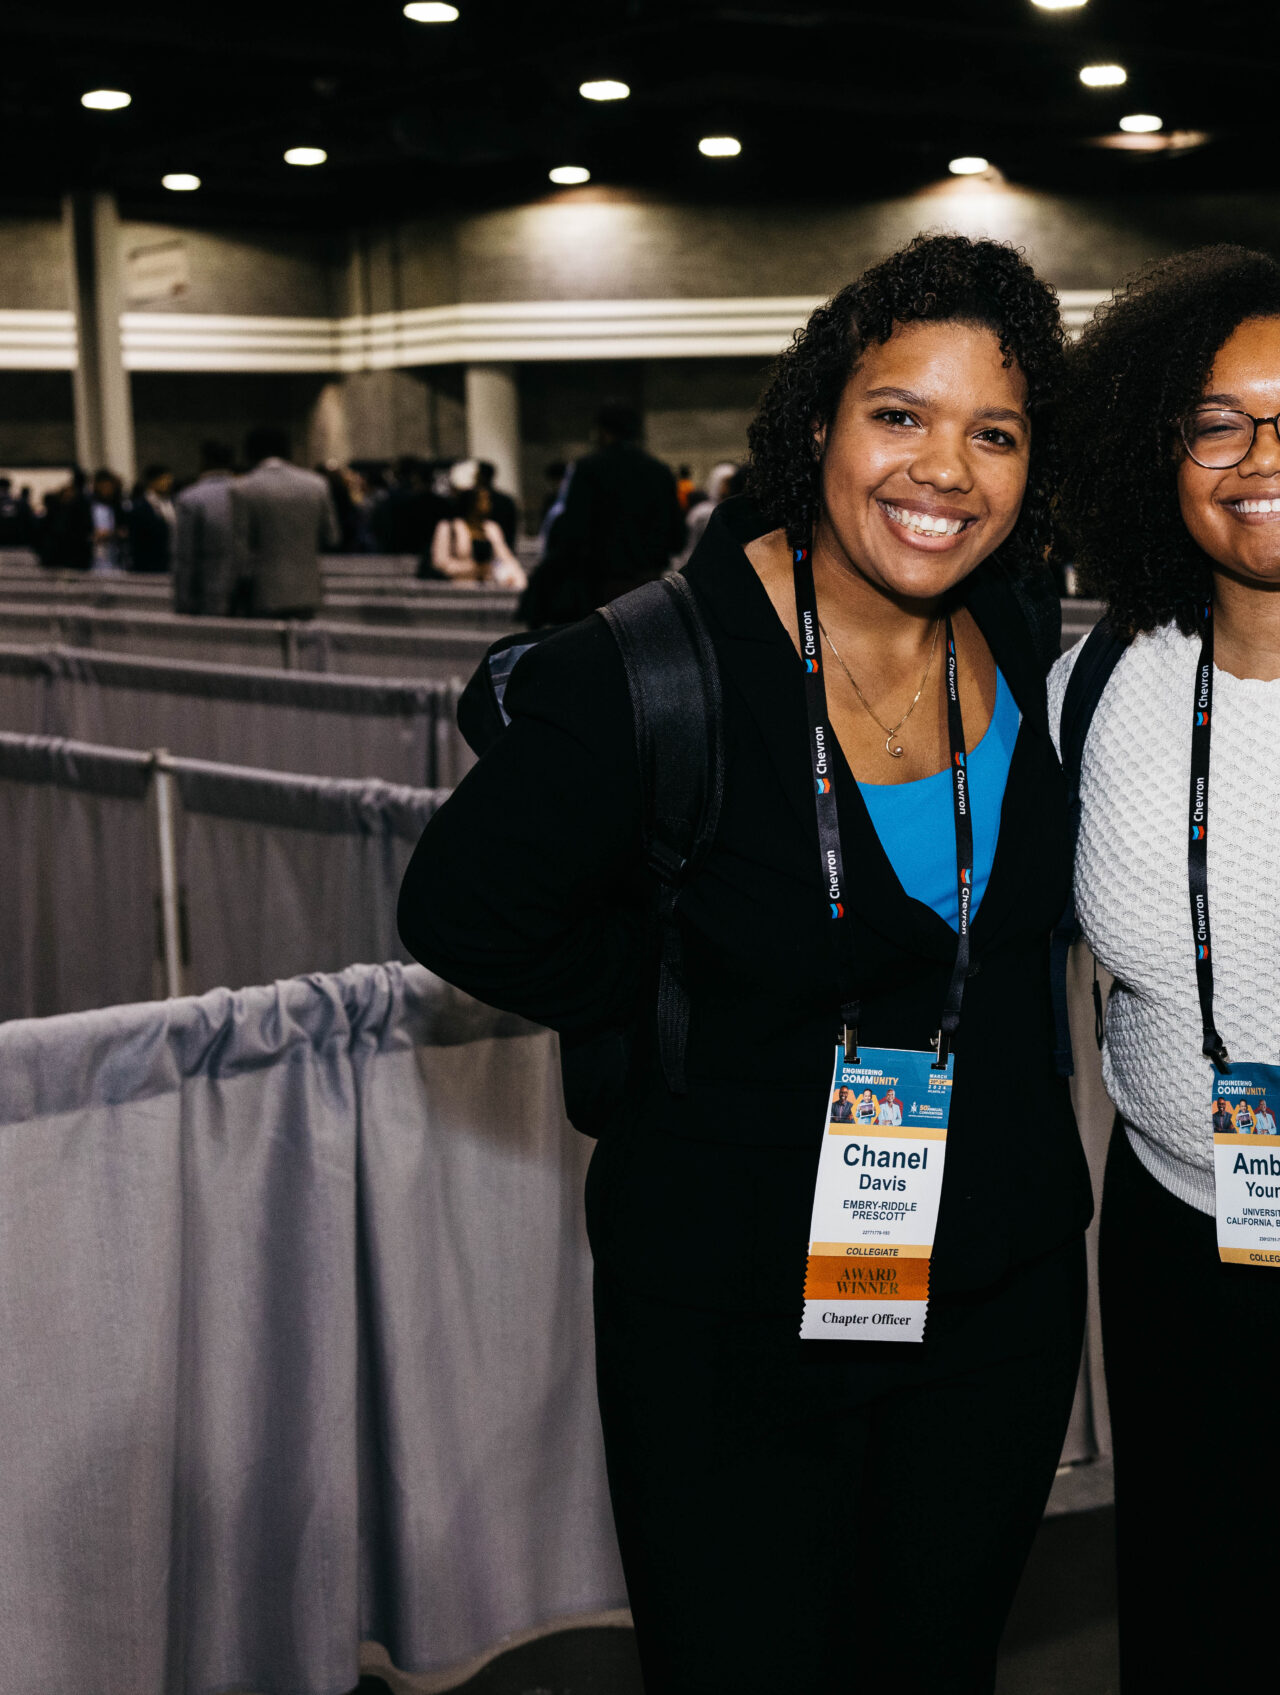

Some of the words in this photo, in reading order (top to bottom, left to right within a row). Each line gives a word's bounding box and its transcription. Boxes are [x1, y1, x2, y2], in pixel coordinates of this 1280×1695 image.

[803, 610, 816, 656] Chevron
[949, 656, 957, 701] Chevron
[1198, 664, 1209, 709] Chevron
[815, 726, 828, 775] Chevron
[956, 769, 966, 815] Chevron
[1193, 777, 1205, 822] Chevron
[827, 850, 840, 899] Chevron
[961, 887, 970, 935] Chevron
[1196, 894, 1207, 941] Chevron
[841, 1074, 899, 1086] COMMUNITY
[1217, 1086, 1266, 1096] COMMUNITY
[843, 1143, 928, 1170] Chanel
[859, 1173, 907, 1192] Davis
[843, 1199, 918, 1212] EMBRY-RIDDLE
[852, 1210, 906, 1221] PRESCOTT
[1226, 1217, 1274, 1228] CALIFORNIA,
[846, 1247, 899, 1257] COLLEGIATE
[841, 1267, 897, 1281] AWARD
[836, 1281, 899, 1295] WINNER
[822, 1312, 869, 1326] Chapter
[871, 1313, 912, 1326] Officer
